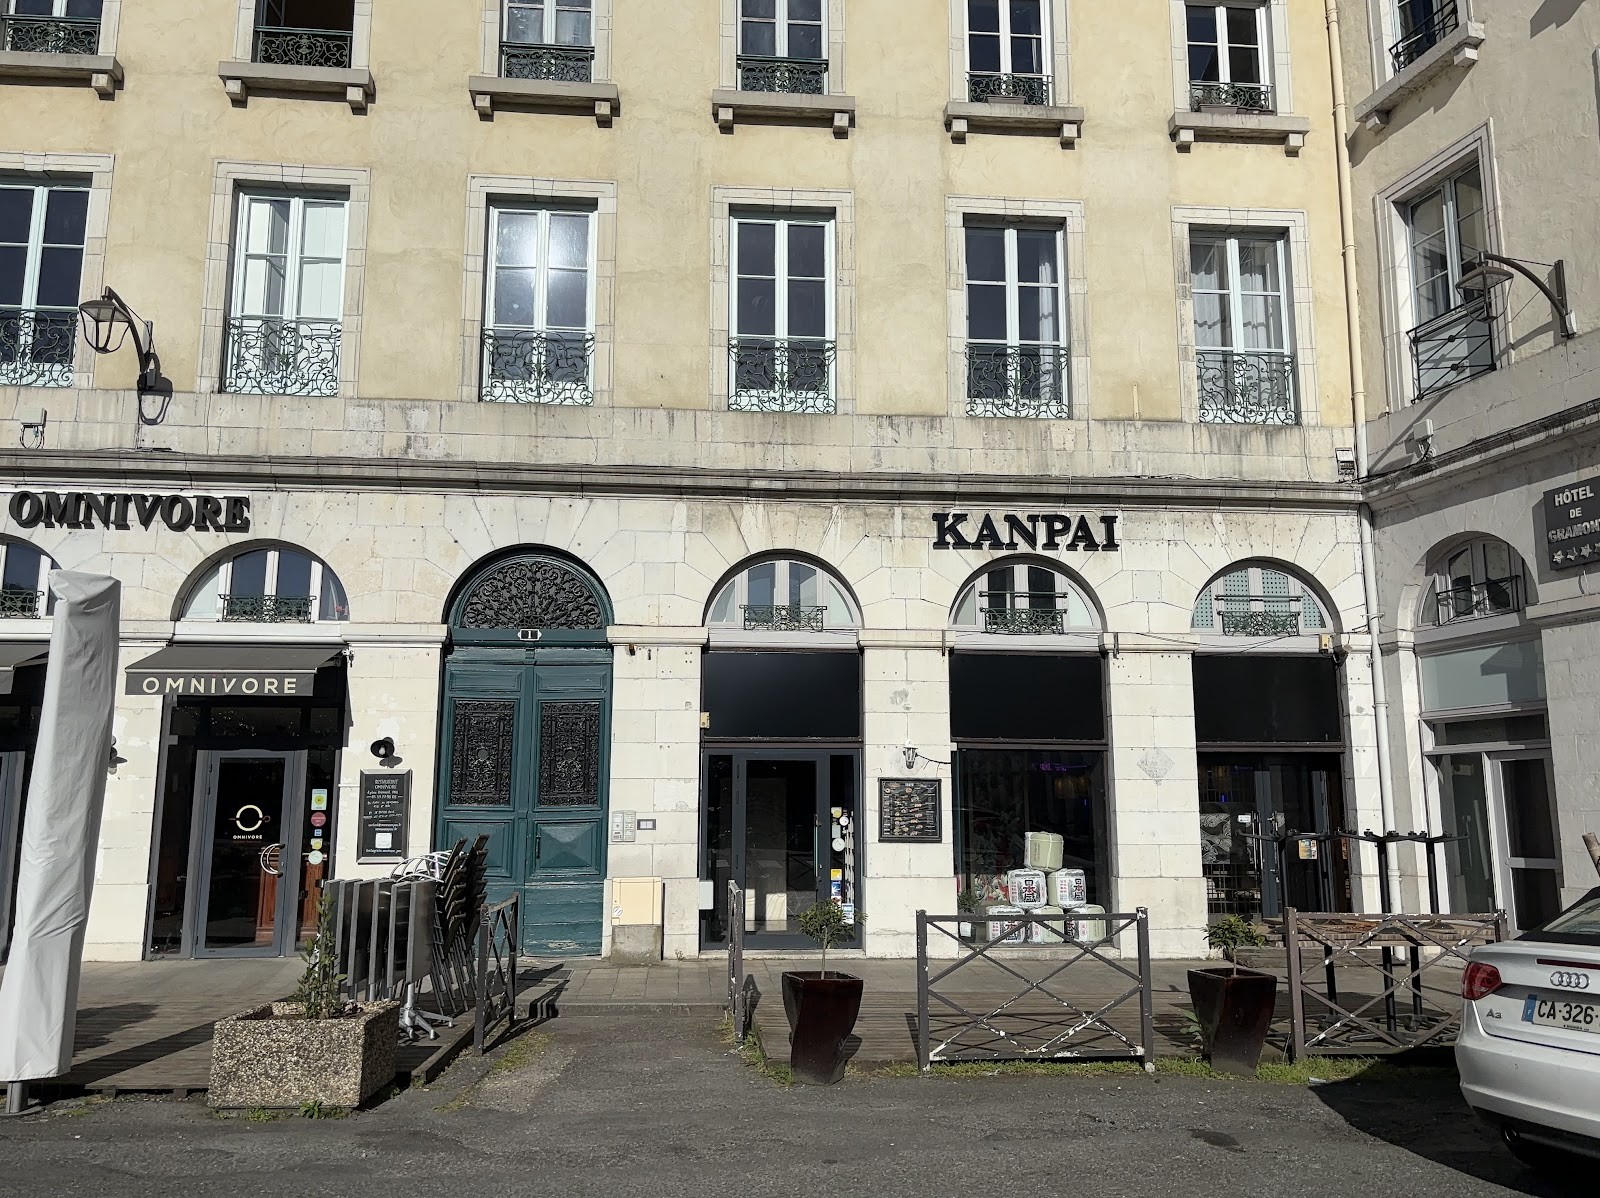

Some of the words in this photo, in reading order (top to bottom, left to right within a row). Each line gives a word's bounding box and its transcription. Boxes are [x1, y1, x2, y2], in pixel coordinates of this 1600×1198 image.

[1554, 485, 1595, 507] HÔTEL
[9, 490, 251, 533] OMNIVORE
[1569, 506, 1583, 519] DE
[932, 512, 1120, 551] KANPAI
[1548, 518, 1600, 543] GRAMON
[142, 676, 297, 694] OMNIVORE
[1486, 1009, 1503, 1019] A3
